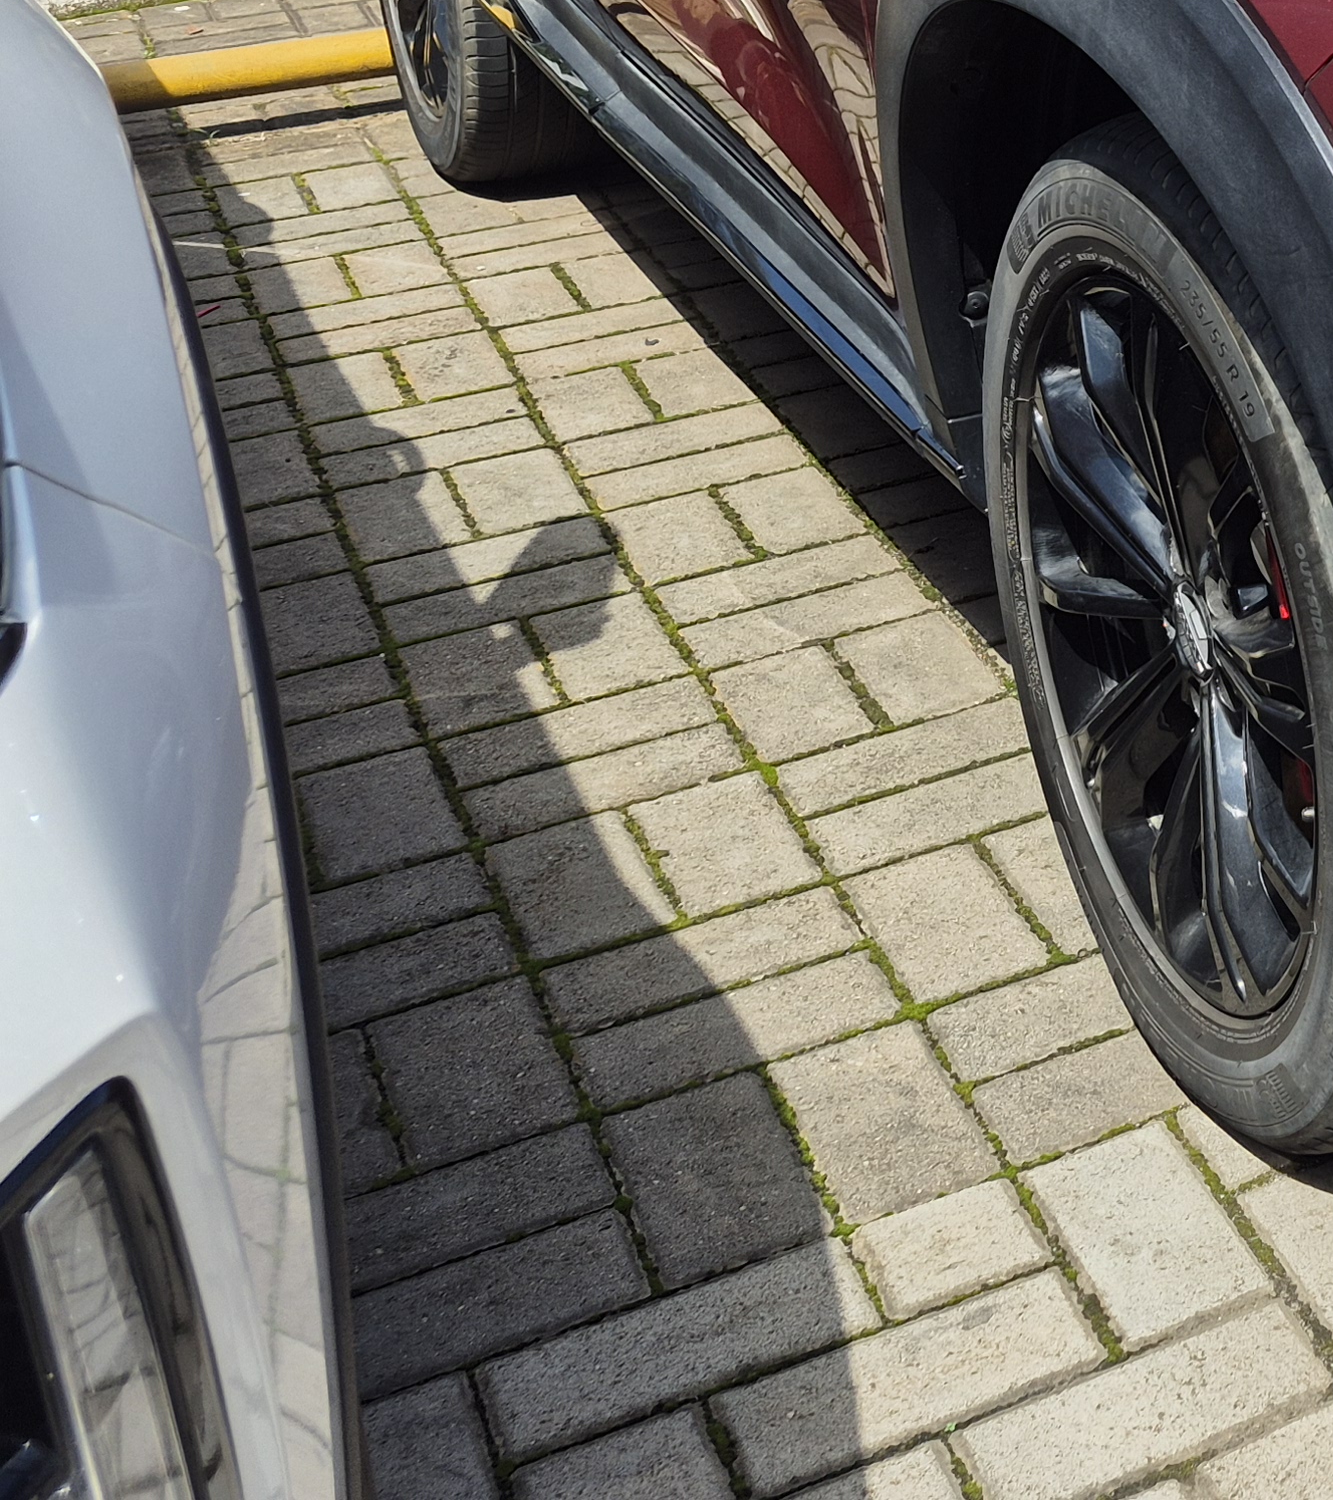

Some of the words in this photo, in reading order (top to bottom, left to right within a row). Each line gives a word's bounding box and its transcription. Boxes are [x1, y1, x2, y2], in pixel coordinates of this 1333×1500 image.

[1038, 182, 1167, 264] MICHELIN
[1180, 280, 1228, 357] 235/55
[1226, 364, 1240, 382] R
[1239, 391, 1255, 418] 19
[1294, 542, 1328, 650] OUTSIDE
